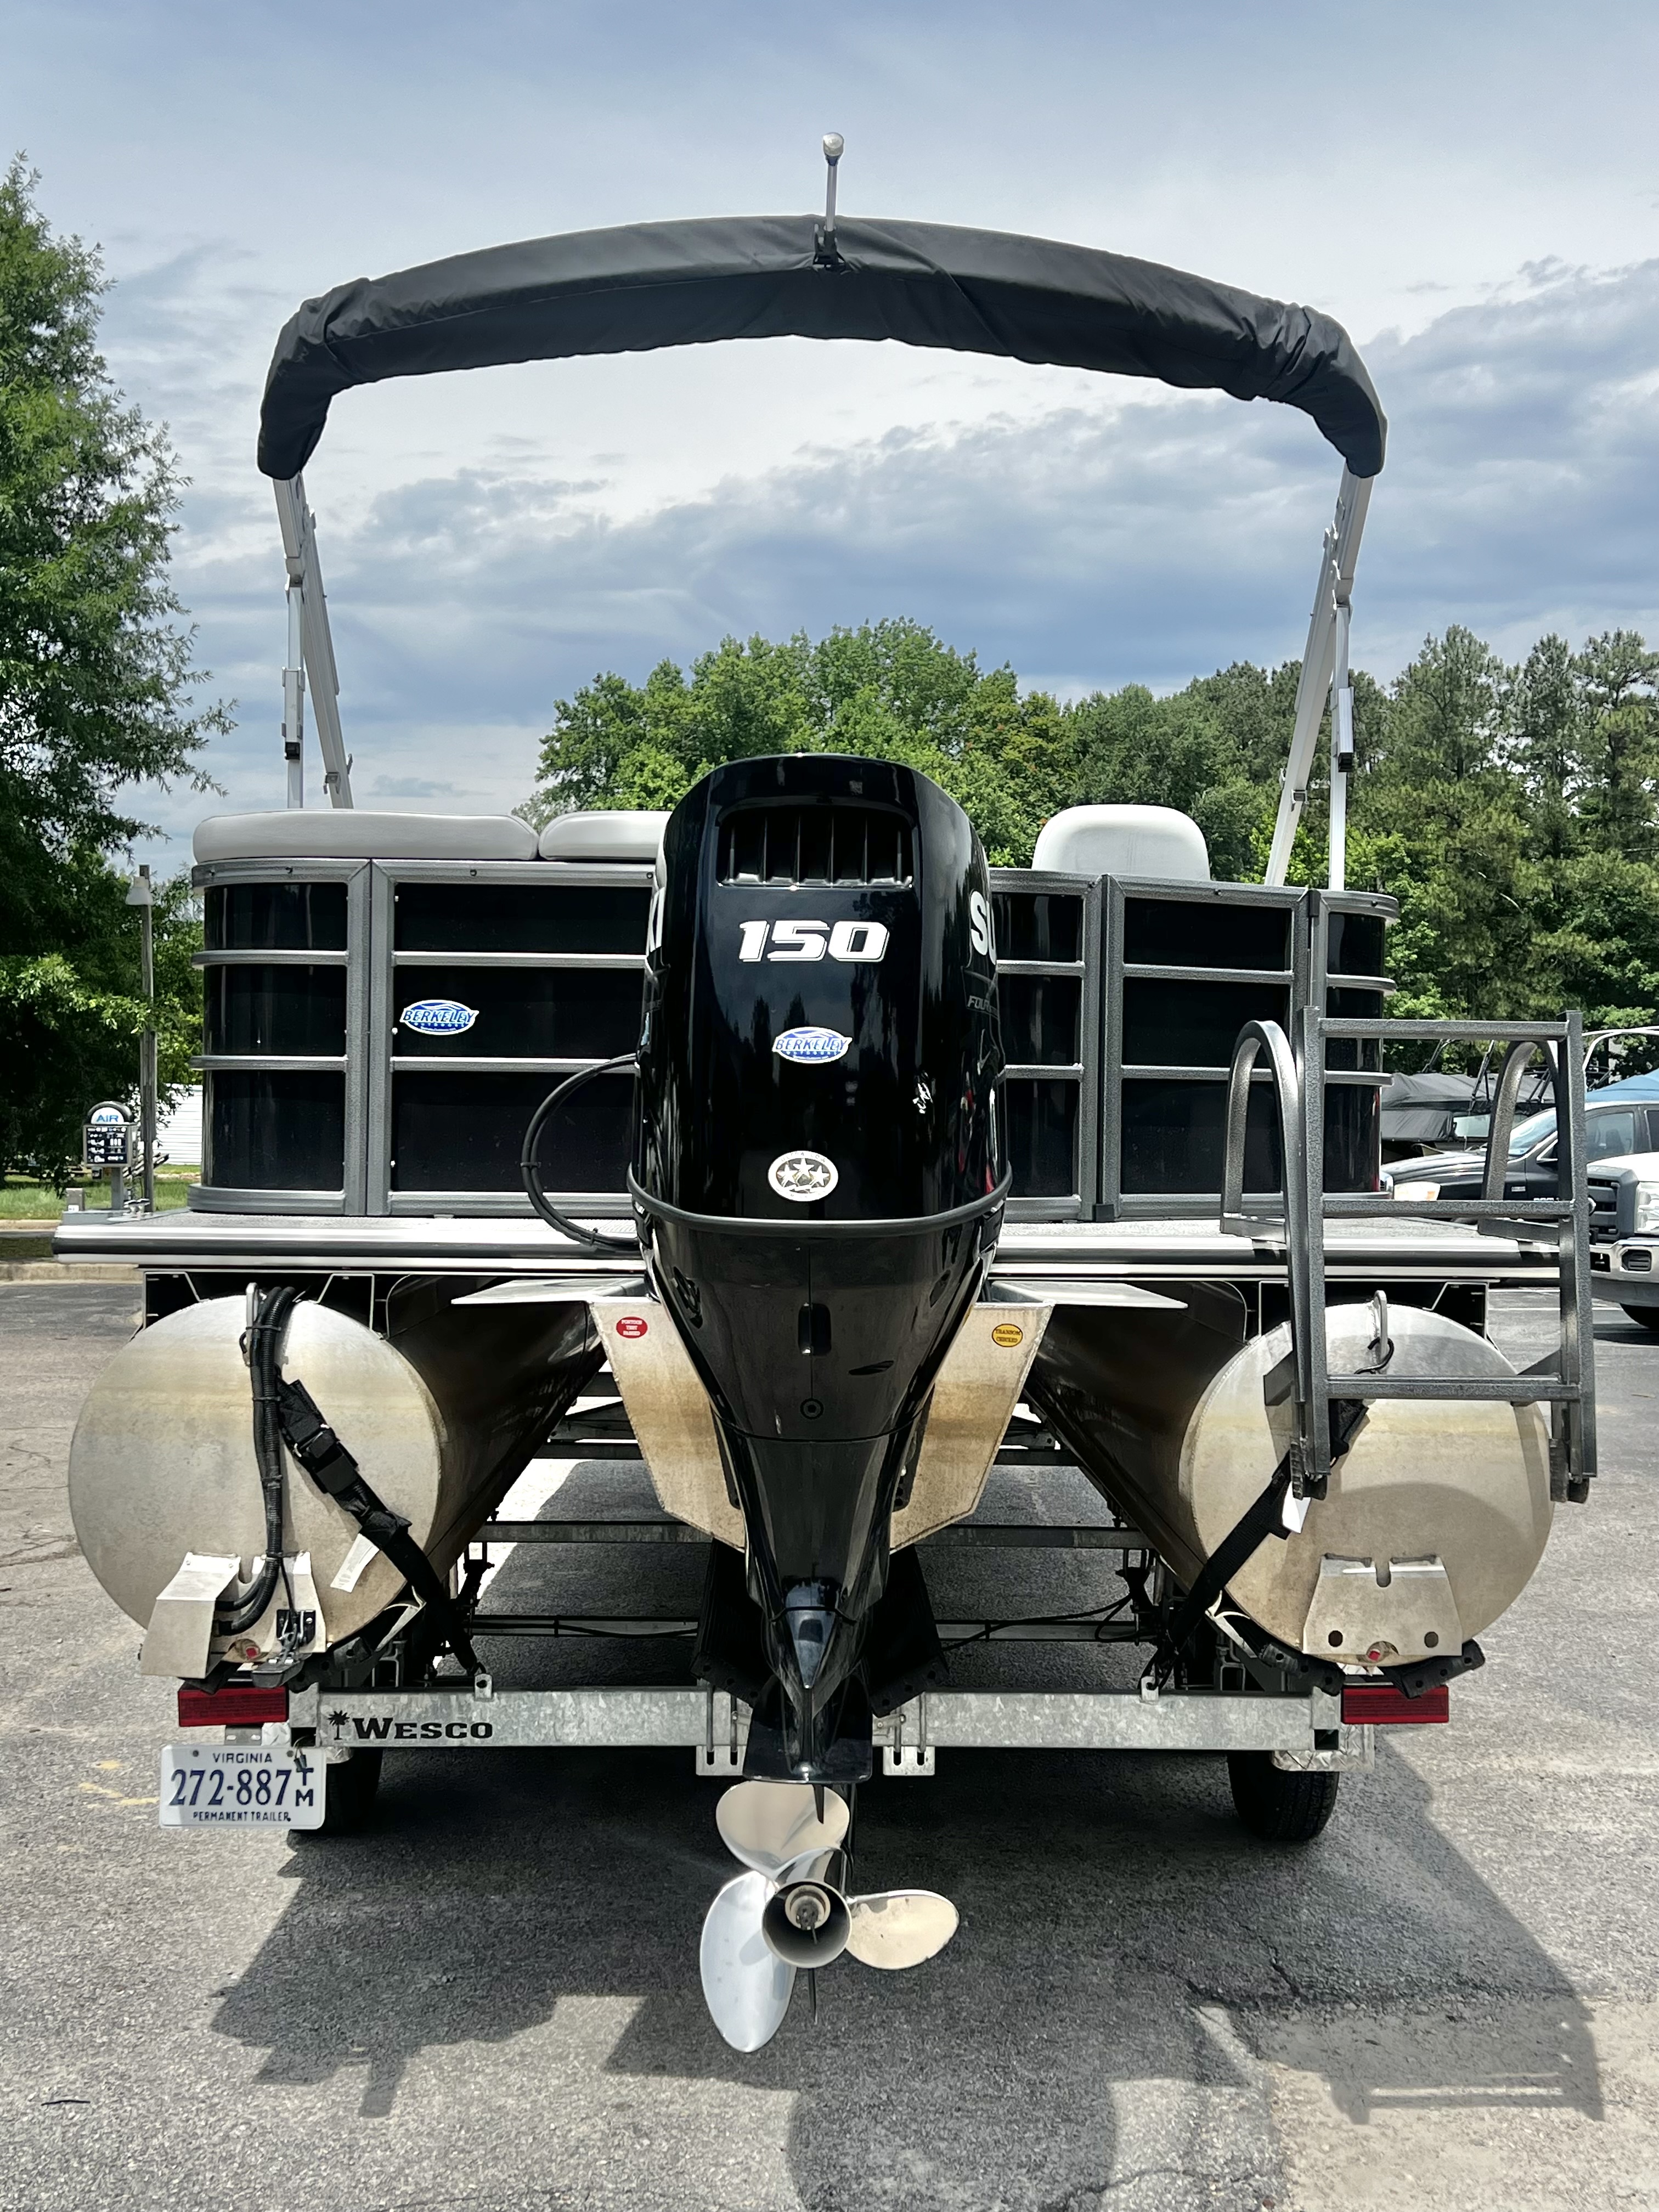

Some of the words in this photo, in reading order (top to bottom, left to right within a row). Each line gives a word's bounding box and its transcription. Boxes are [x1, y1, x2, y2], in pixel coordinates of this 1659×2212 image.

[739, 920, 890, 962] 150
[403, 1010, 475, 1023] BERKELEY
[775, 1039, 848, 1050] BERKELEY
[352, 1718, 493, 1739] WESCO
[212, 1753, 273, 1763] VIRGINIA
[169, 1769, 292, 1806] 272-887
[193, 1812, 247, 1821] PERMANENT
[251, 1812, 290, 1822] TRAILER
